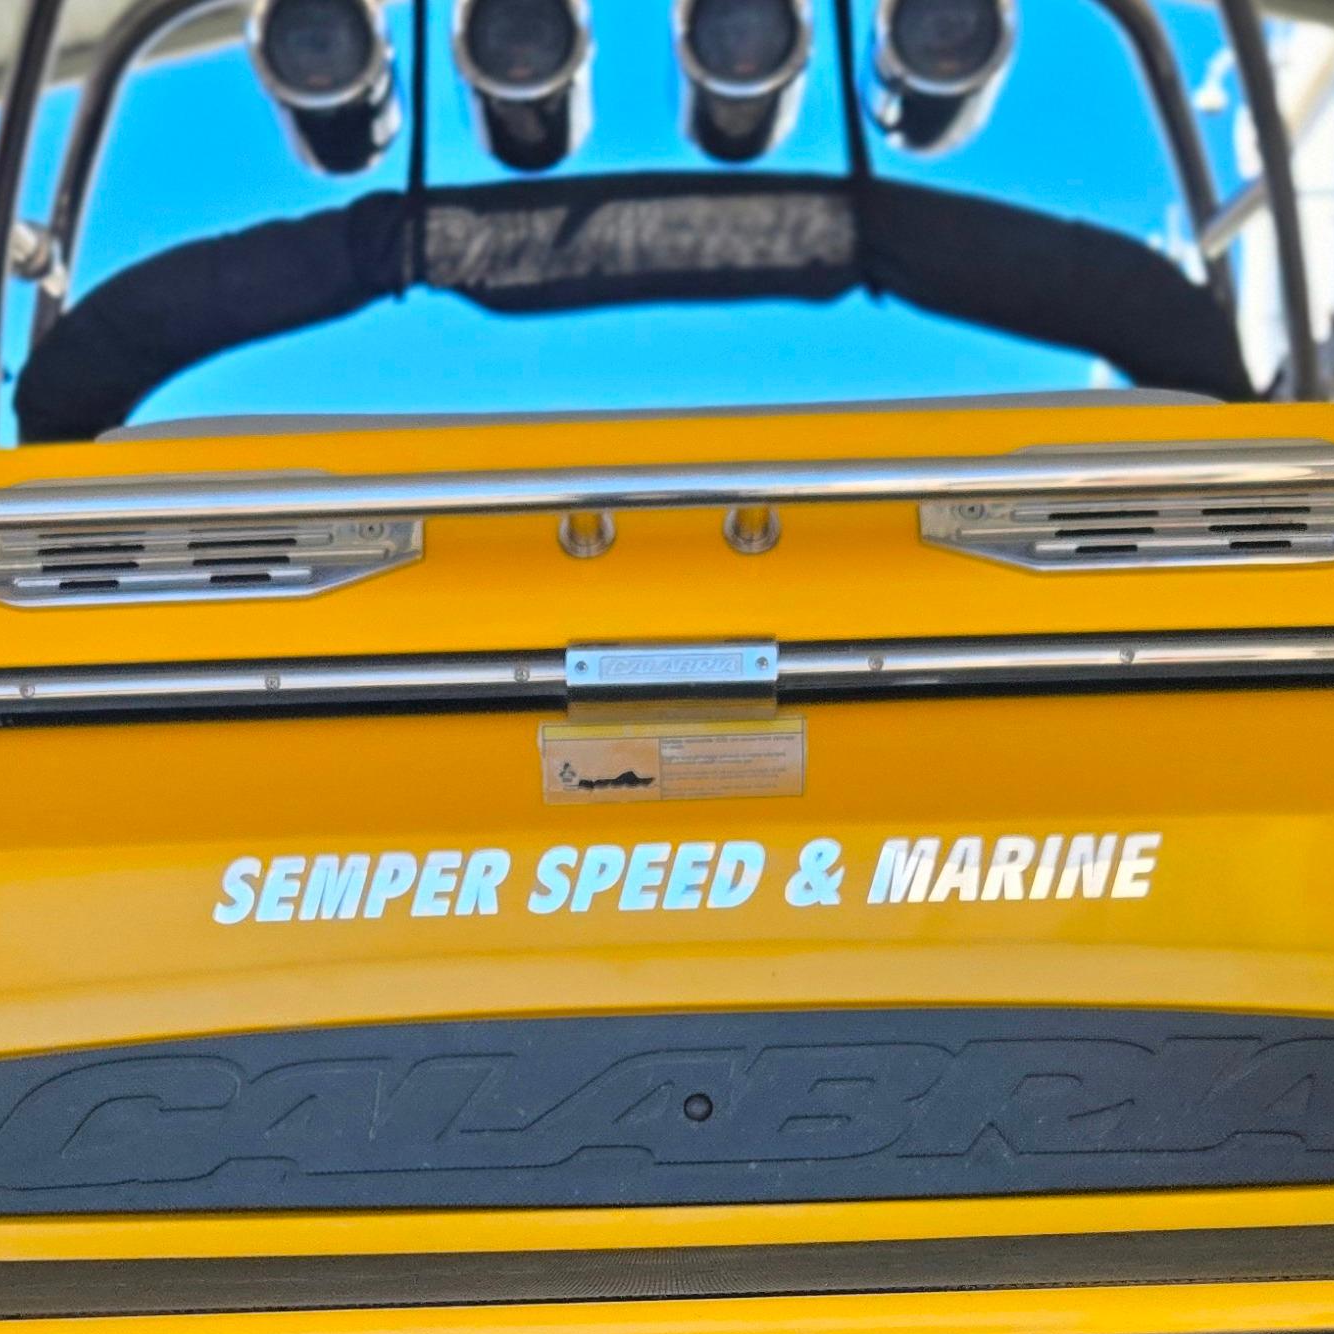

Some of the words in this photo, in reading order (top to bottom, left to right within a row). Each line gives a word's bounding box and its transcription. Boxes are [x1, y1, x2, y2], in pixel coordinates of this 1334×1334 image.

[212, 848, 510, 924] SEMPER
[527, 841, 766, 913] SPEED
[785, 837, 844, 907] &
[867, 833, 1161, 904] MARINE
